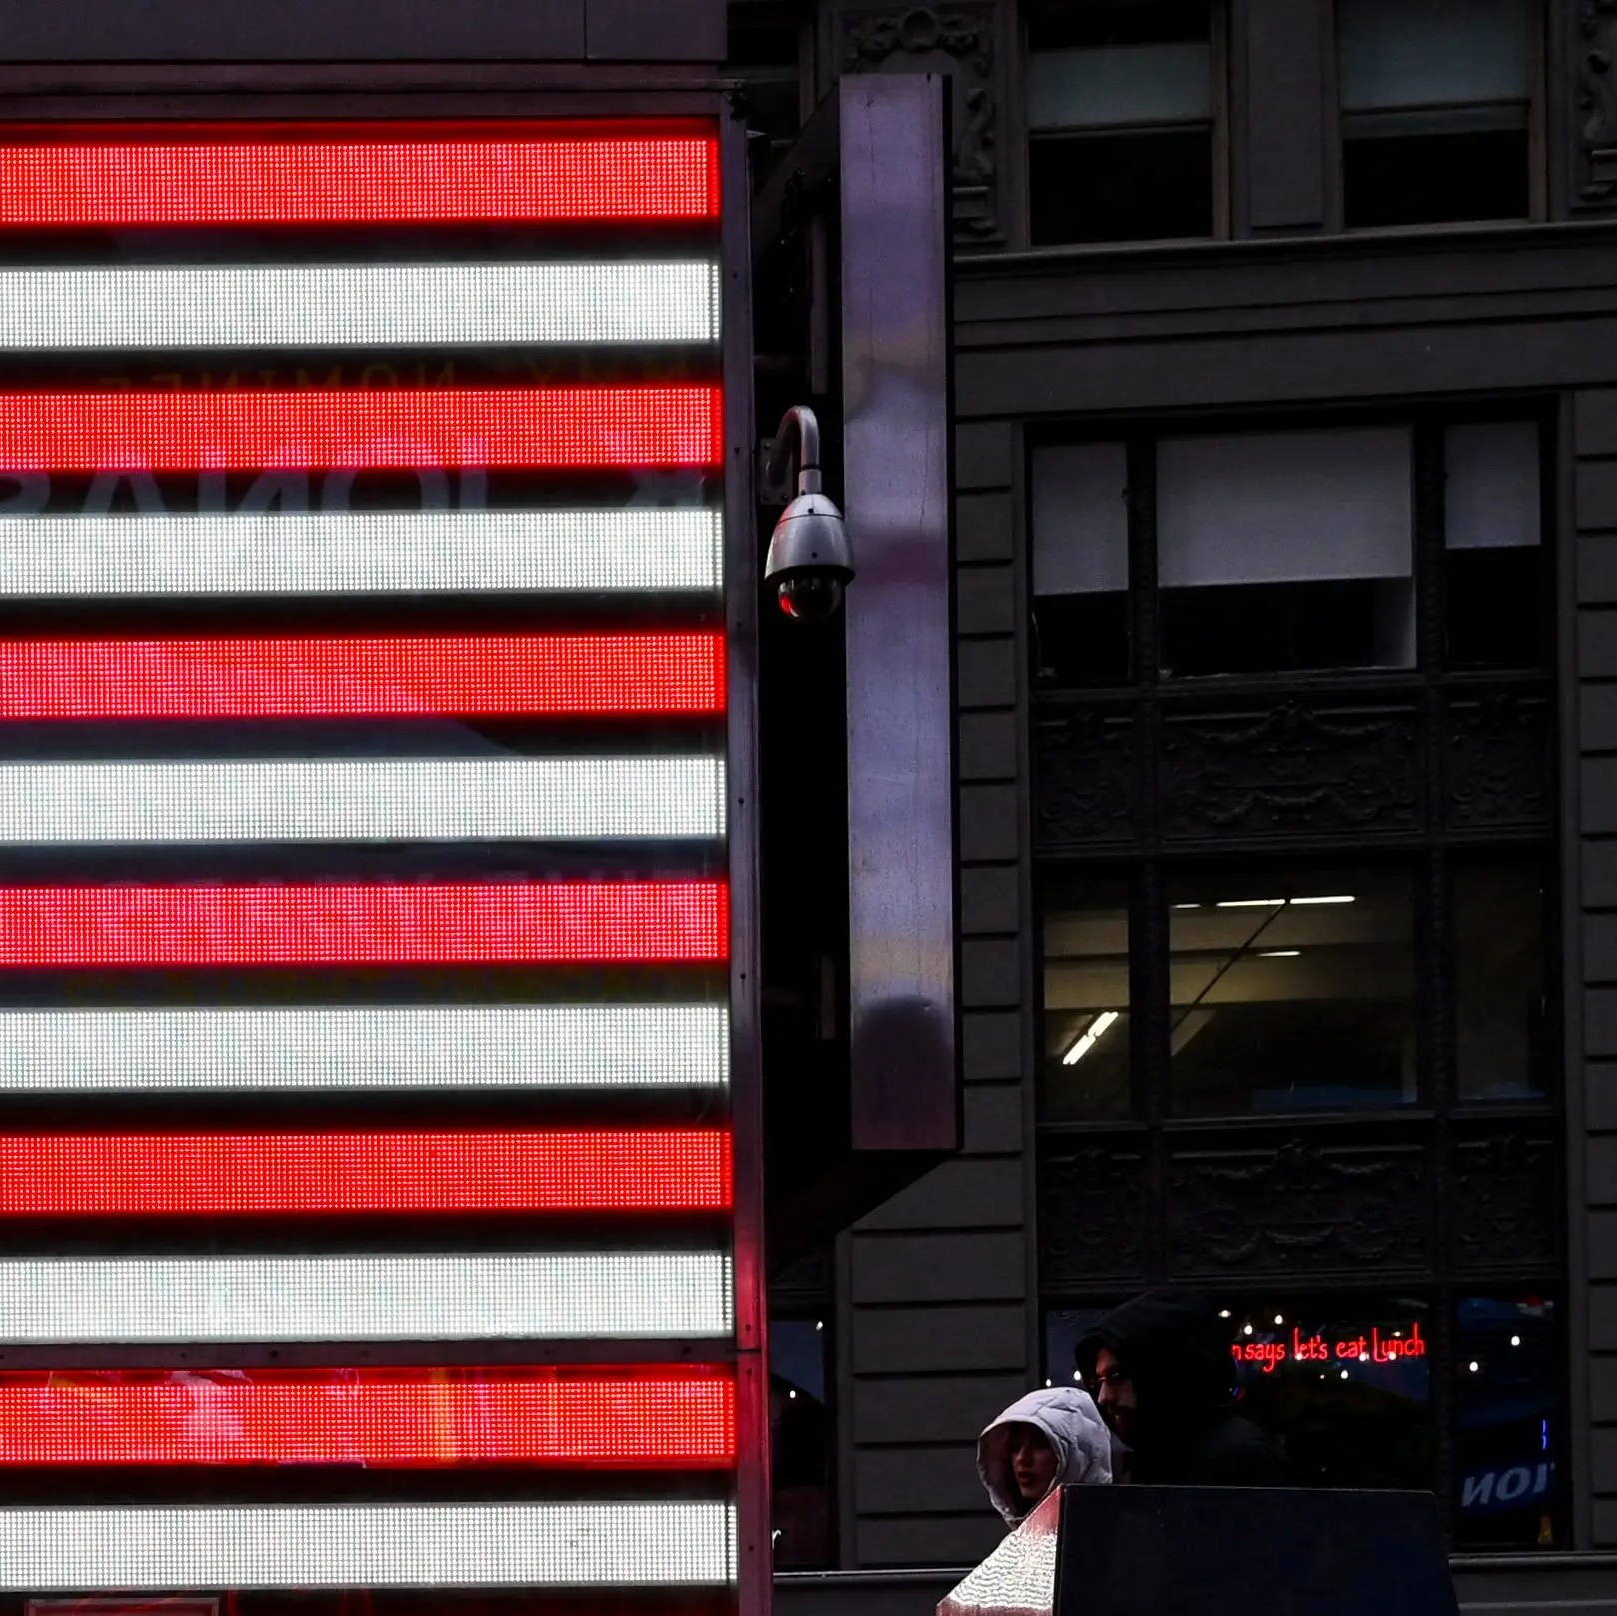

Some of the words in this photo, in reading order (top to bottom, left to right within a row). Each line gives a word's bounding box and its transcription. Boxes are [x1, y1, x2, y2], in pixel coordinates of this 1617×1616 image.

[1245, 1342, 1285, 1372] says
[1294, 1327, 1328, 1360] let's
[1335, 1336, 1367, 1358] eat
[1371, 1322, 1425, 1363] Lunch
